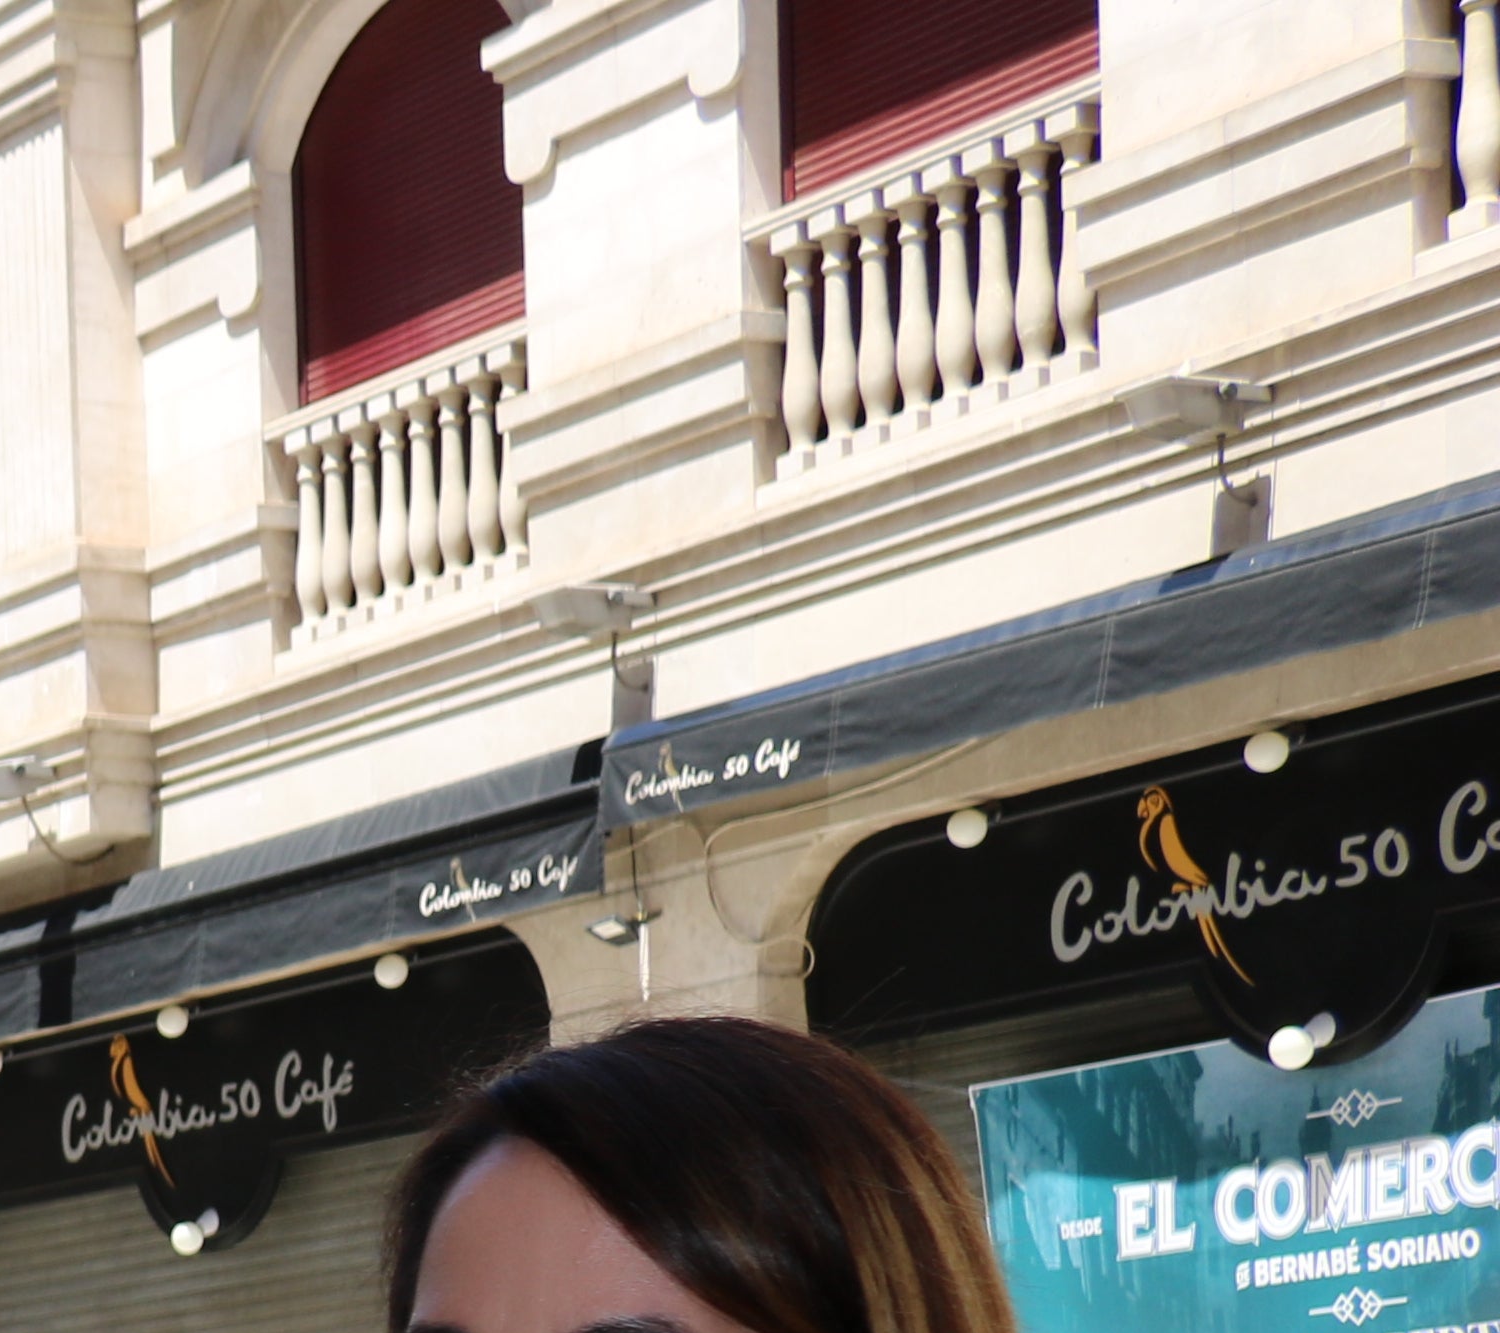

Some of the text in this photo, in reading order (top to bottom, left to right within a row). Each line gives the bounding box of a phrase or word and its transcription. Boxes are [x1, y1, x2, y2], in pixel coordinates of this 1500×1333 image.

[625, 759, 714, 805] Colombia
[723, 755, 749, 780] 50
[418, 878, 503, 918] Colombia
[508, 867, 531, 892] 50
[1050, 852, 1328, 963] Colombia
[1335, 828, 1410, 888] 50
[61, 1049, 355, 1163] Colombia 50 Café
[1113, 1115, 1500, 1262] EL COMERC
[1254, 1239, 1362, 1288] BERNABÉ
[1367, 1227, 1481, 1272] SORIANO
